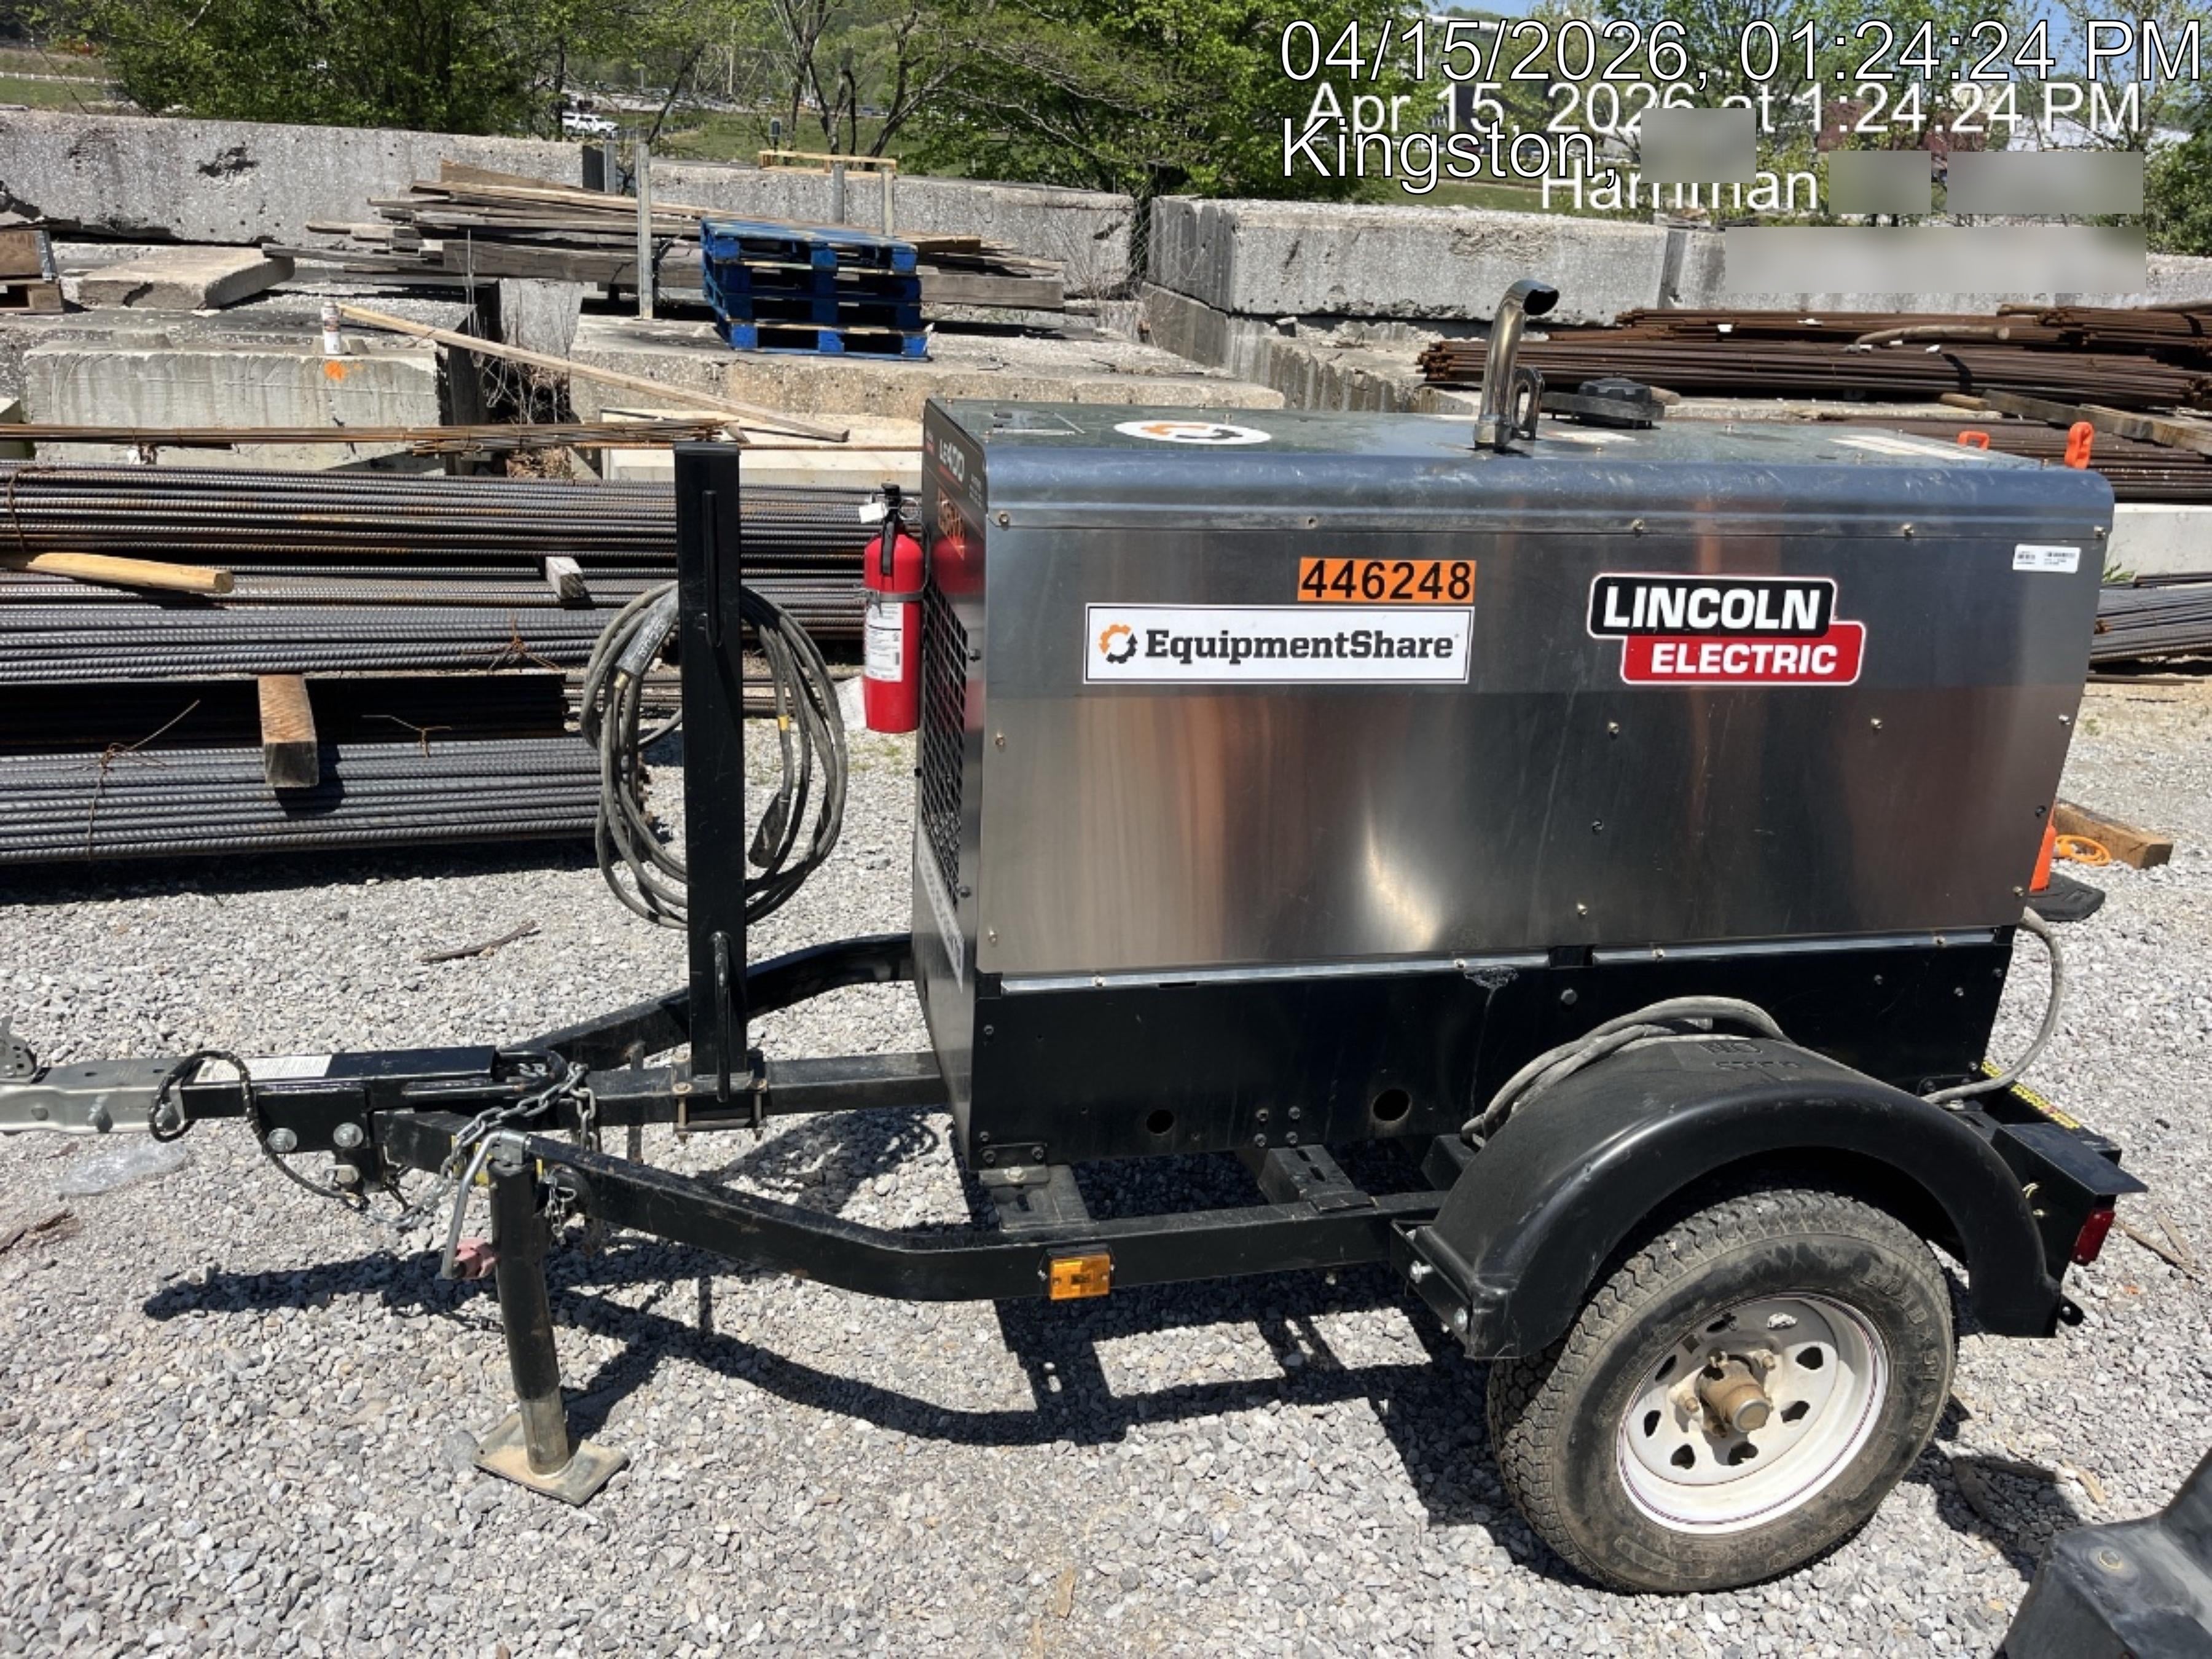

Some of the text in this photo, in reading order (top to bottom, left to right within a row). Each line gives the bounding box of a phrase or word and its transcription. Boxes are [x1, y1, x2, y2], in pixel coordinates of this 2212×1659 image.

[1302, 560, 1471, 600] 446248
[1603, 586, 1821, 630] LINCOLN
[1145, 629, 1454, 665] EquipmentShare
[1650, 643, 1838, 675] ELECTRIC
